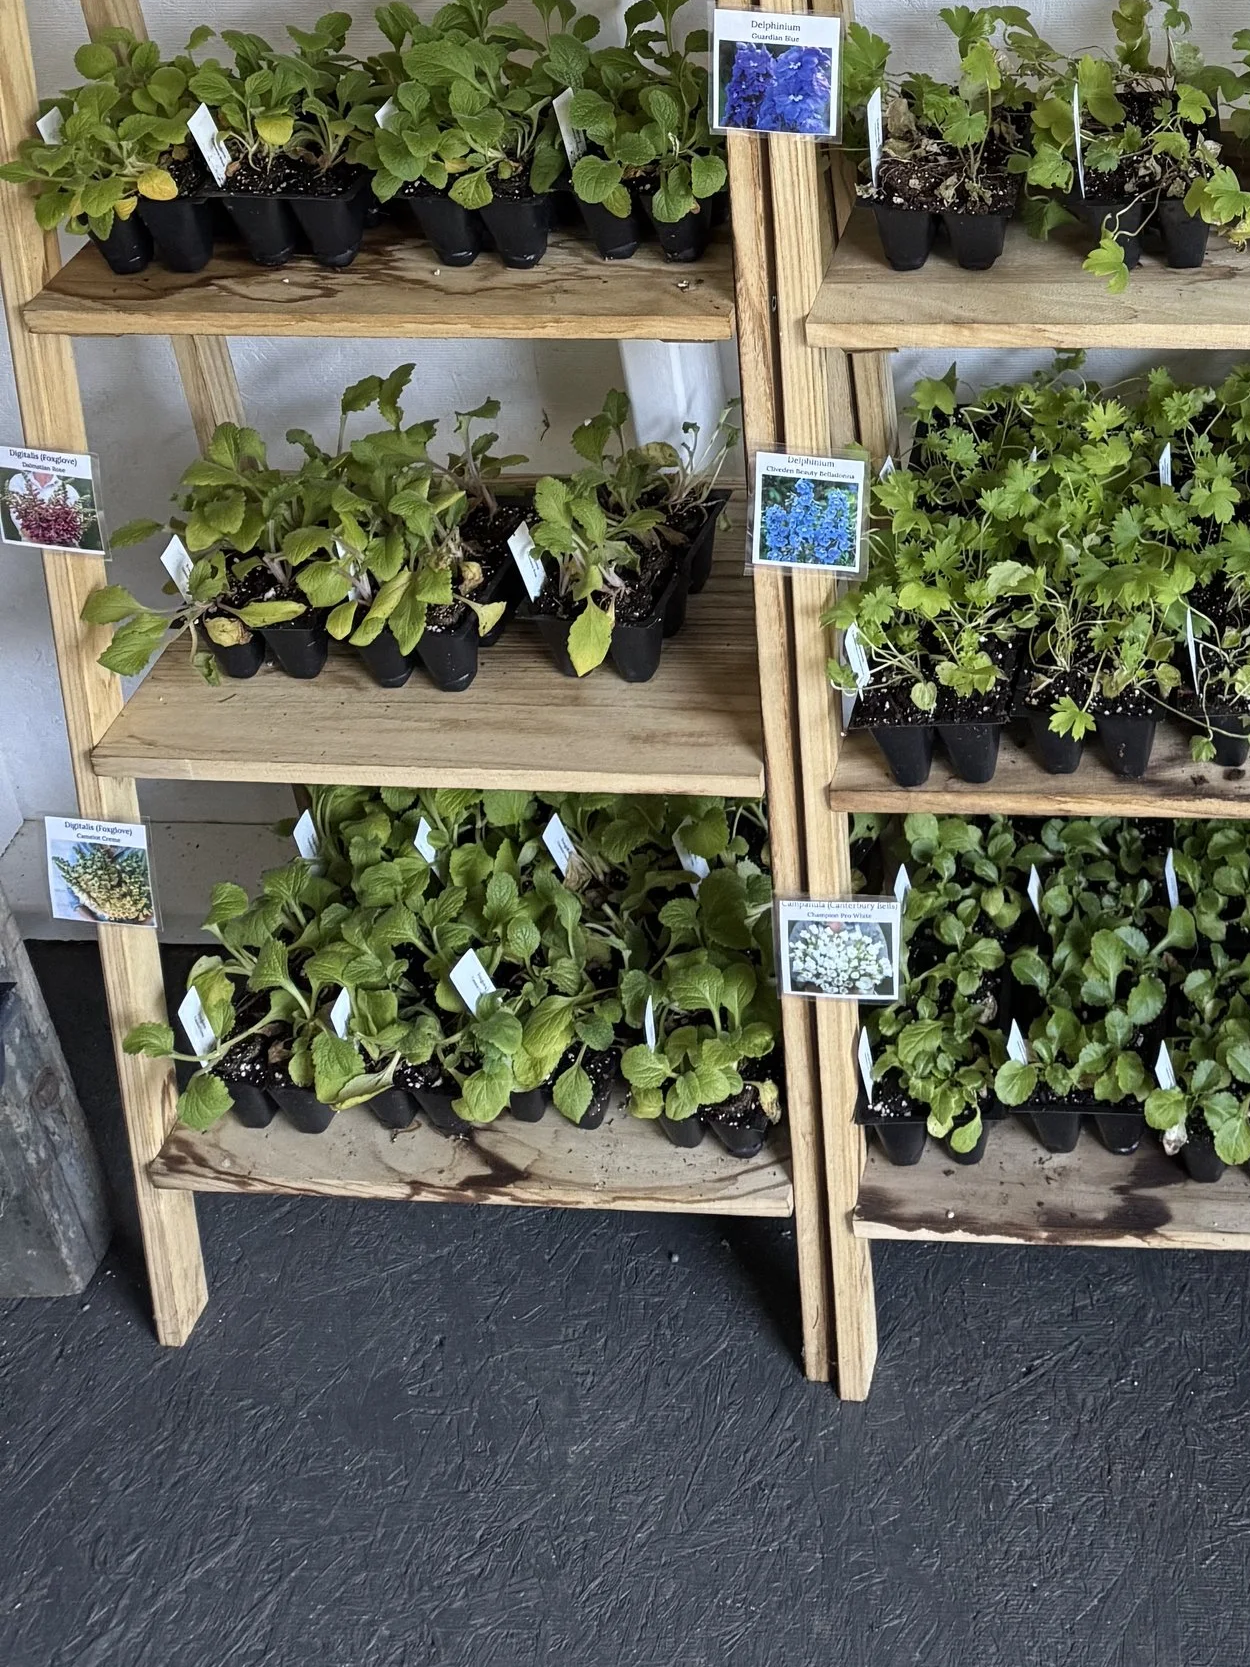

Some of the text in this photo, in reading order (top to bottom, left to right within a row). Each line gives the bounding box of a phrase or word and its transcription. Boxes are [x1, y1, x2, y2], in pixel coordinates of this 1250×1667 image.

[751, 20, 801, 32] Delphinium
[751, 33, 783, 41] Guardian
[9, 449, 78, 467] Digitalis (Foxglove)
[787, 456, 835, 467] Delphinium
[64, 821, 133, 836] Digitalis (Foxglove)
